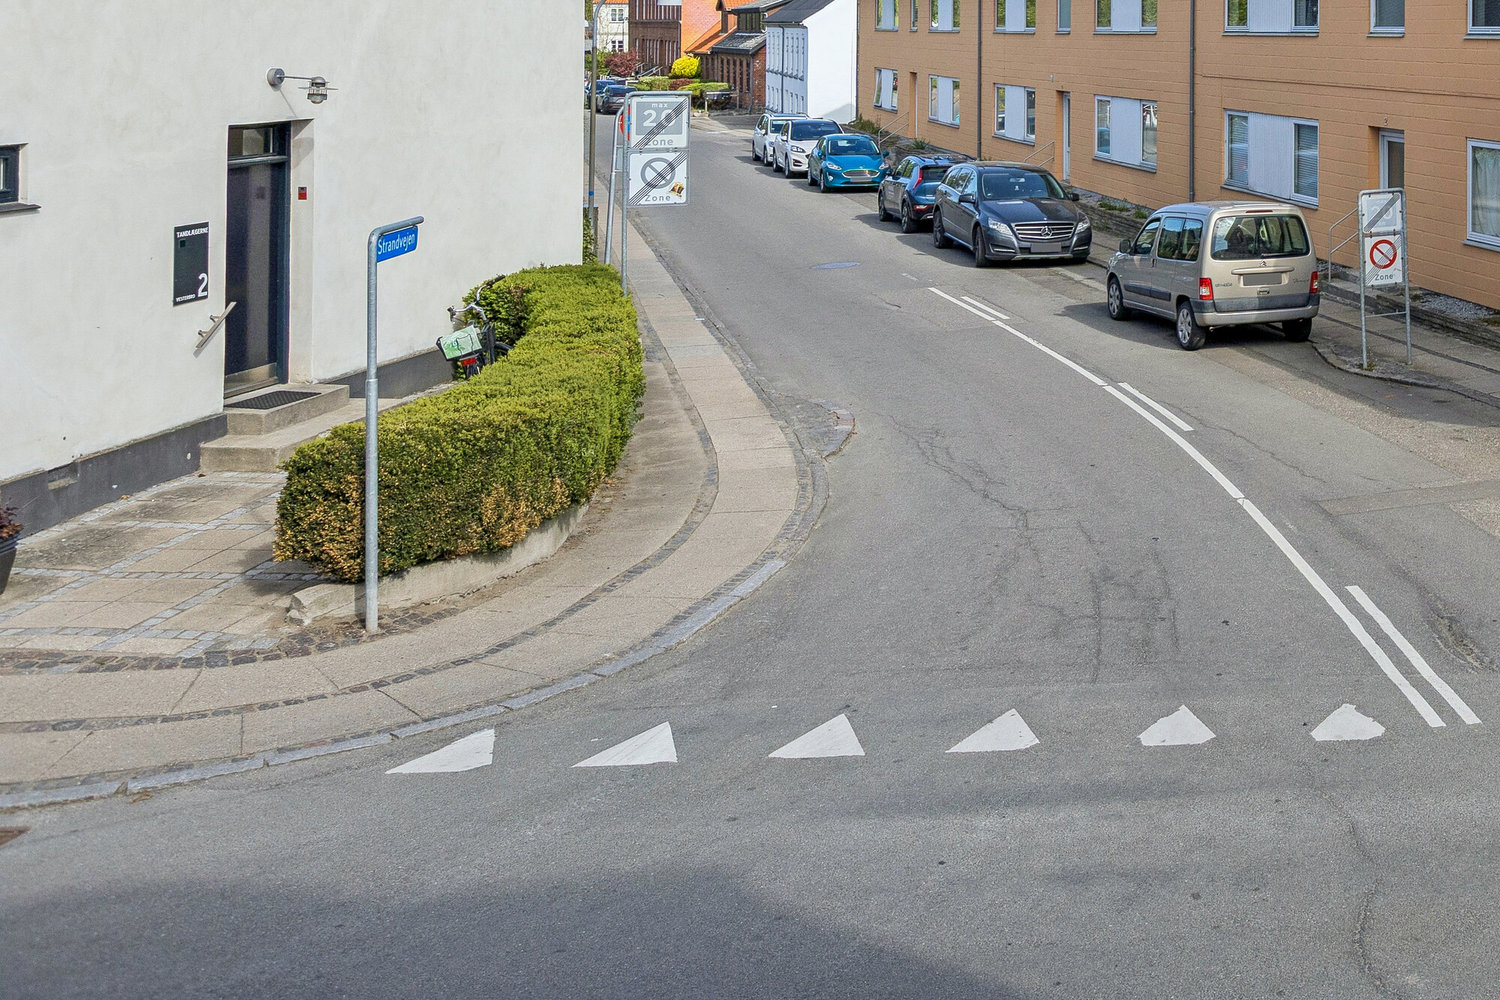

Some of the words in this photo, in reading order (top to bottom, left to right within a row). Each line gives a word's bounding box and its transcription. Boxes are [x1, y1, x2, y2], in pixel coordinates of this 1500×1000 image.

[644, 194, 671, 202] Zone
[377, 231, 416, 255] Strandvejen
[197, 272, 208, 297] 2
[1374, 273, 1394, 281] Zone
